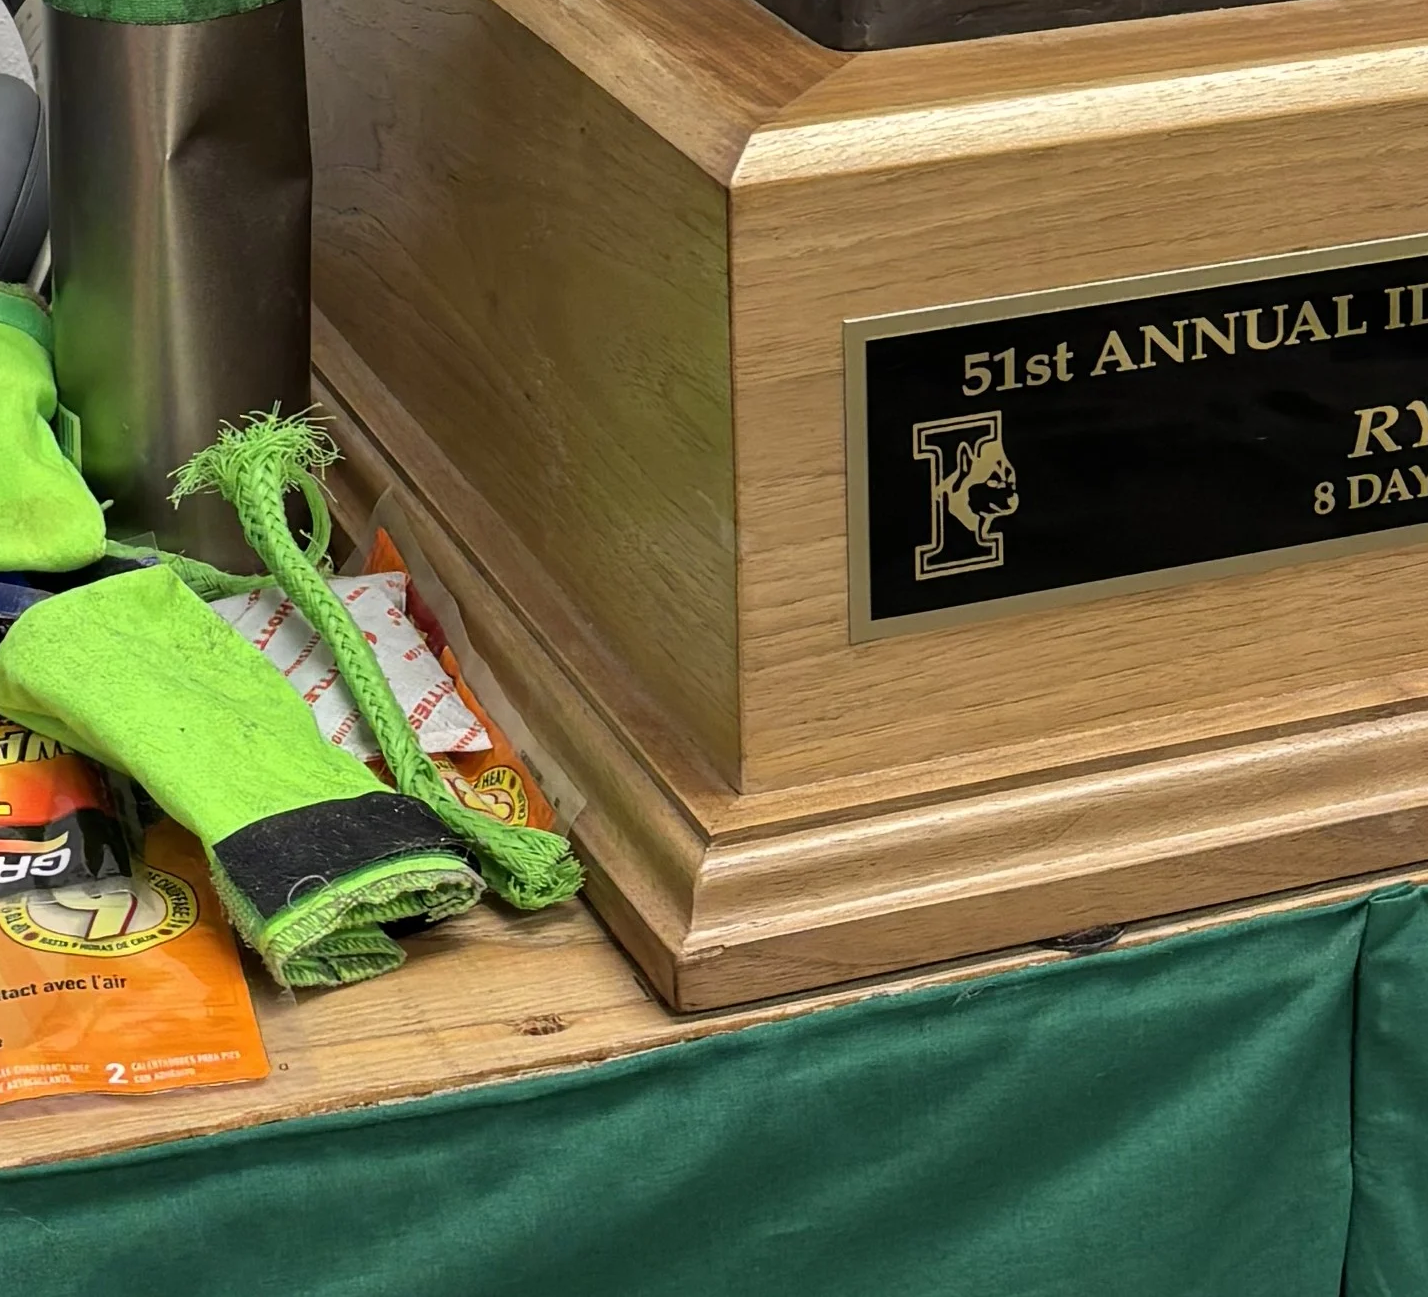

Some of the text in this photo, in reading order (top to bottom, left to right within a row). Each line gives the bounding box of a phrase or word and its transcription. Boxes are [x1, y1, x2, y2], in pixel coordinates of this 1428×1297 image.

[962, 341, 1074, 397] 51st
[1090, 295, 1367, 378] ANNUAL
[1313, 480, 1336, 515] 8
[43, 977, 88, 993] avec
[91, 974, 128, 991] l'air
[105, 1062, 129, 1084] 2
